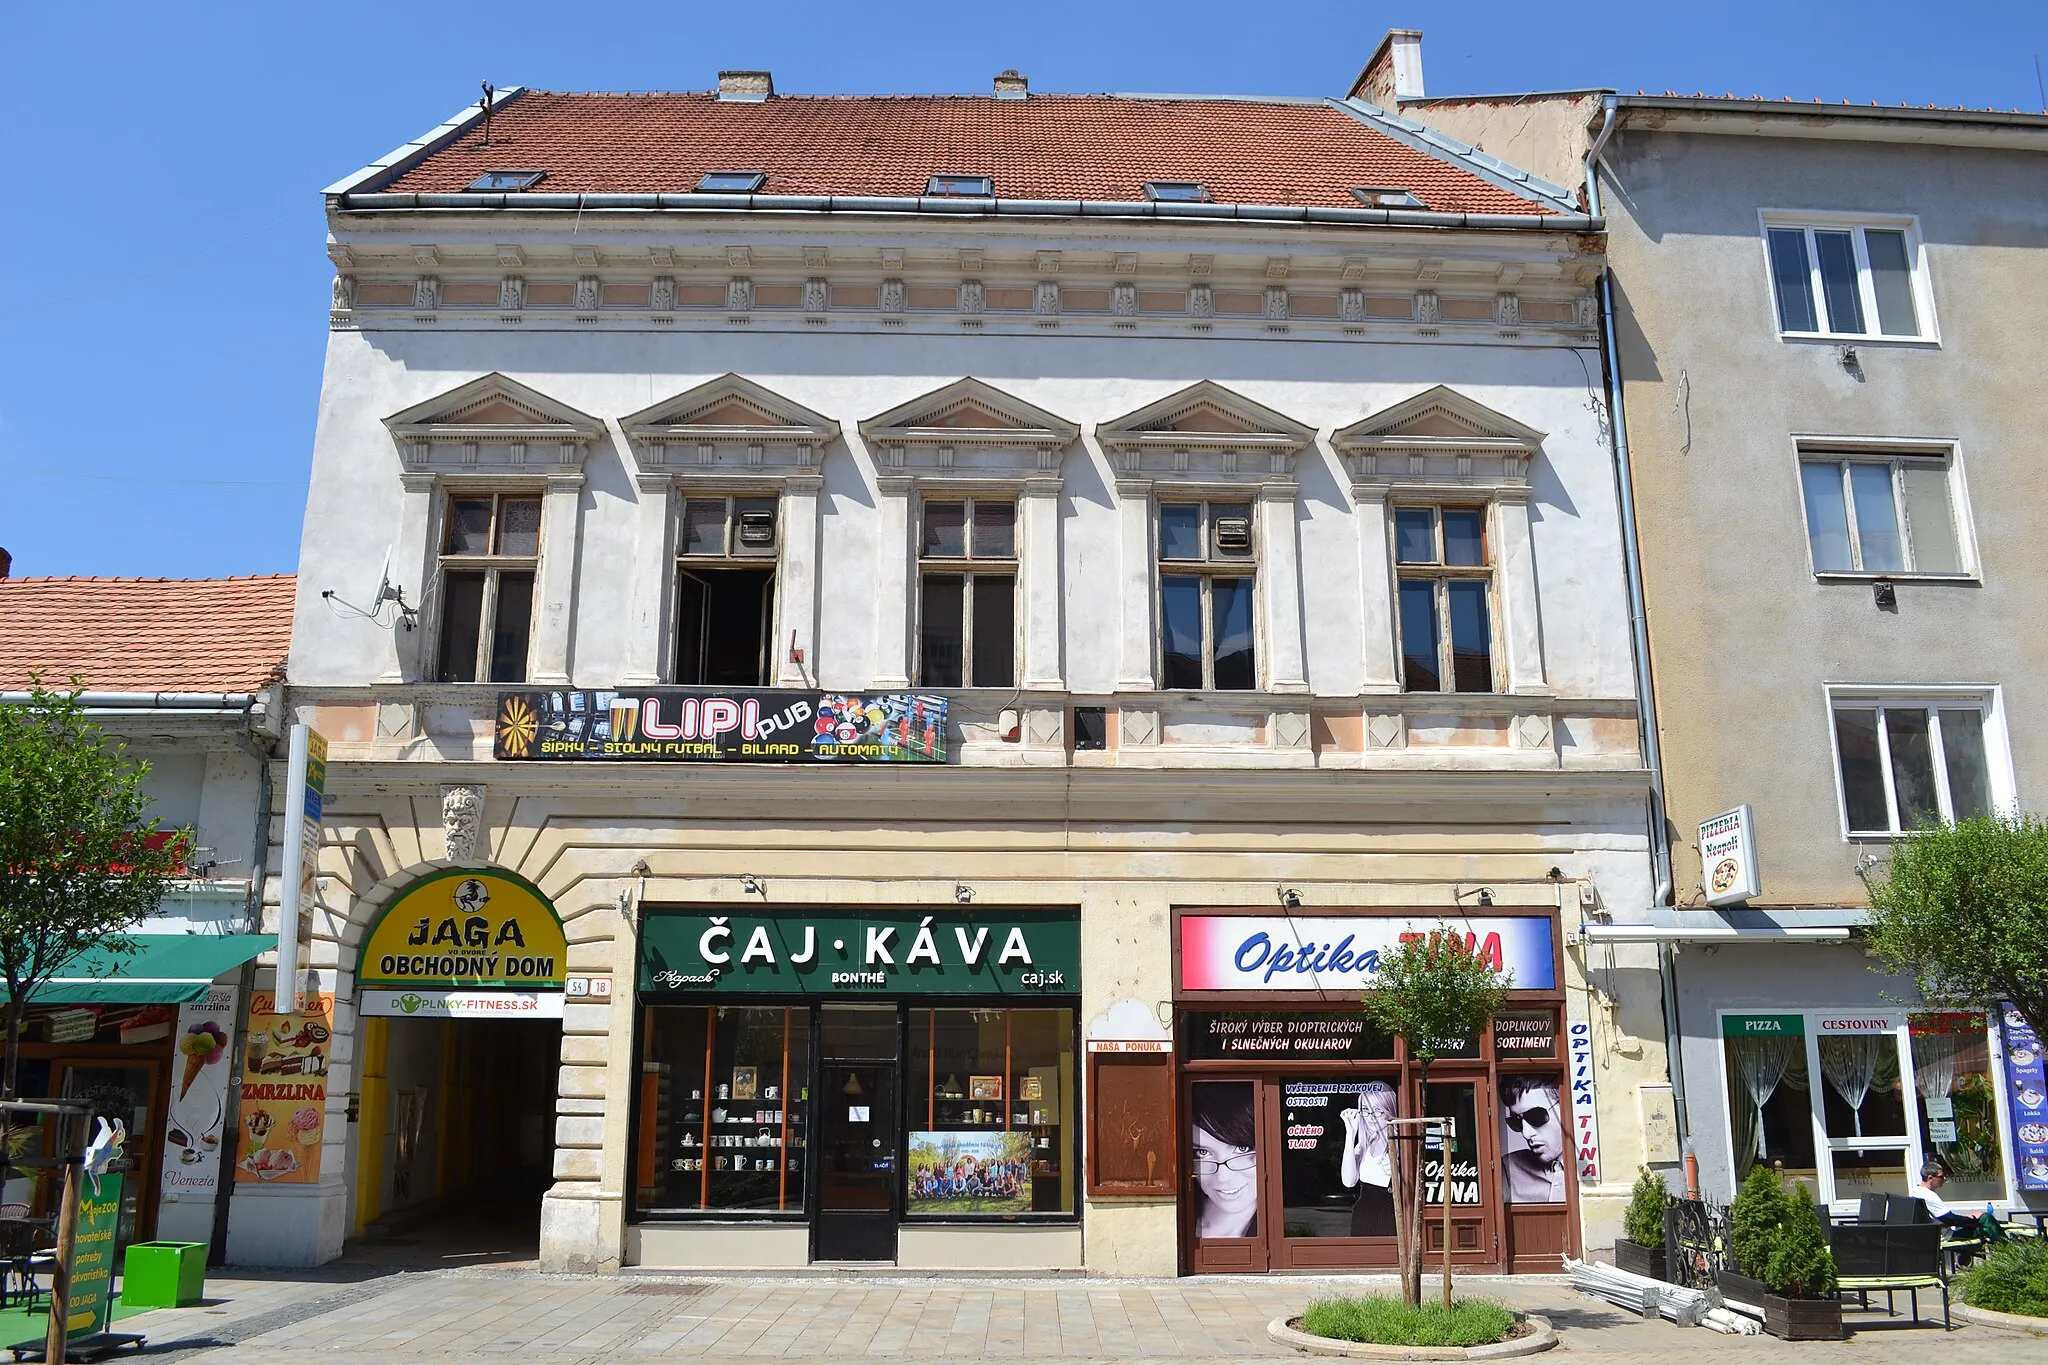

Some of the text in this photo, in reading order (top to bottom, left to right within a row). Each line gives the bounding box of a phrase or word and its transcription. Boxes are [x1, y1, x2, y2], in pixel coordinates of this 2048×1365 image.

[642, 698, 812, 741] LIPI PUB
[665, 742, 722, 754] FUTBAL
[742, 743, 799, 755] BILIARD
[819, 744, 899, 757] AUTOMATY
[408, 916, 526, 949] JAGA
[699, 916, 1032, 964] ČAJ KÁVA
[380, 951, 554, 977] OBCHODNÝ DOM
[1235, 932, 1381, 983] Optika
[832, 971, 885, 983] BONTHÉ
[1021, 970, 1064, 987] caj.sk
[572, 981, 582, 992] 54
[596, 982, 606, 993] 18
[190, 1003, 230, 1012] zmrzlina
[1209, 1020, 1363, 1033] ŠIROKÝ VÝBER DIOPTRICKÝCH
[1495, 1018, 1551, 1031] DOPLNKOVÝ
[1745, 1020, 1781, 1031] PIZZA
[1822, 1020, 1889, 1030] CESTOVINY
[1096, 1040, 1162, 1052] NAŠA PONUKA
[1231, 1036, 1290, 1050] SLNEČNÝCH
[1294, 1038, 1352, 1050] OKULIAROV
[1497, 1036, 1552, 1048] SORTIMENT
[241, 1083, 326, 1101] ZMRZLINA
[1285, 1083, 1383, 1094] VYŠETRENIE ZRAKOVEJ
[1286, 1097, 1328, 1106] OSTROSTI
[1570, 1023, 1597, 1177] OPTIKA TINA
[1287, 1112, 1294, 1121] A
[1287, 1124, 1324, 1136] OČNÉHO
[1288, 1139, 1317, 1149] TLAKU
[75, 1228, 112, 1243] hovateľské
[76, 1251, 102, 1266] potreby
[80, 1293, 97, 1306] JAGA
